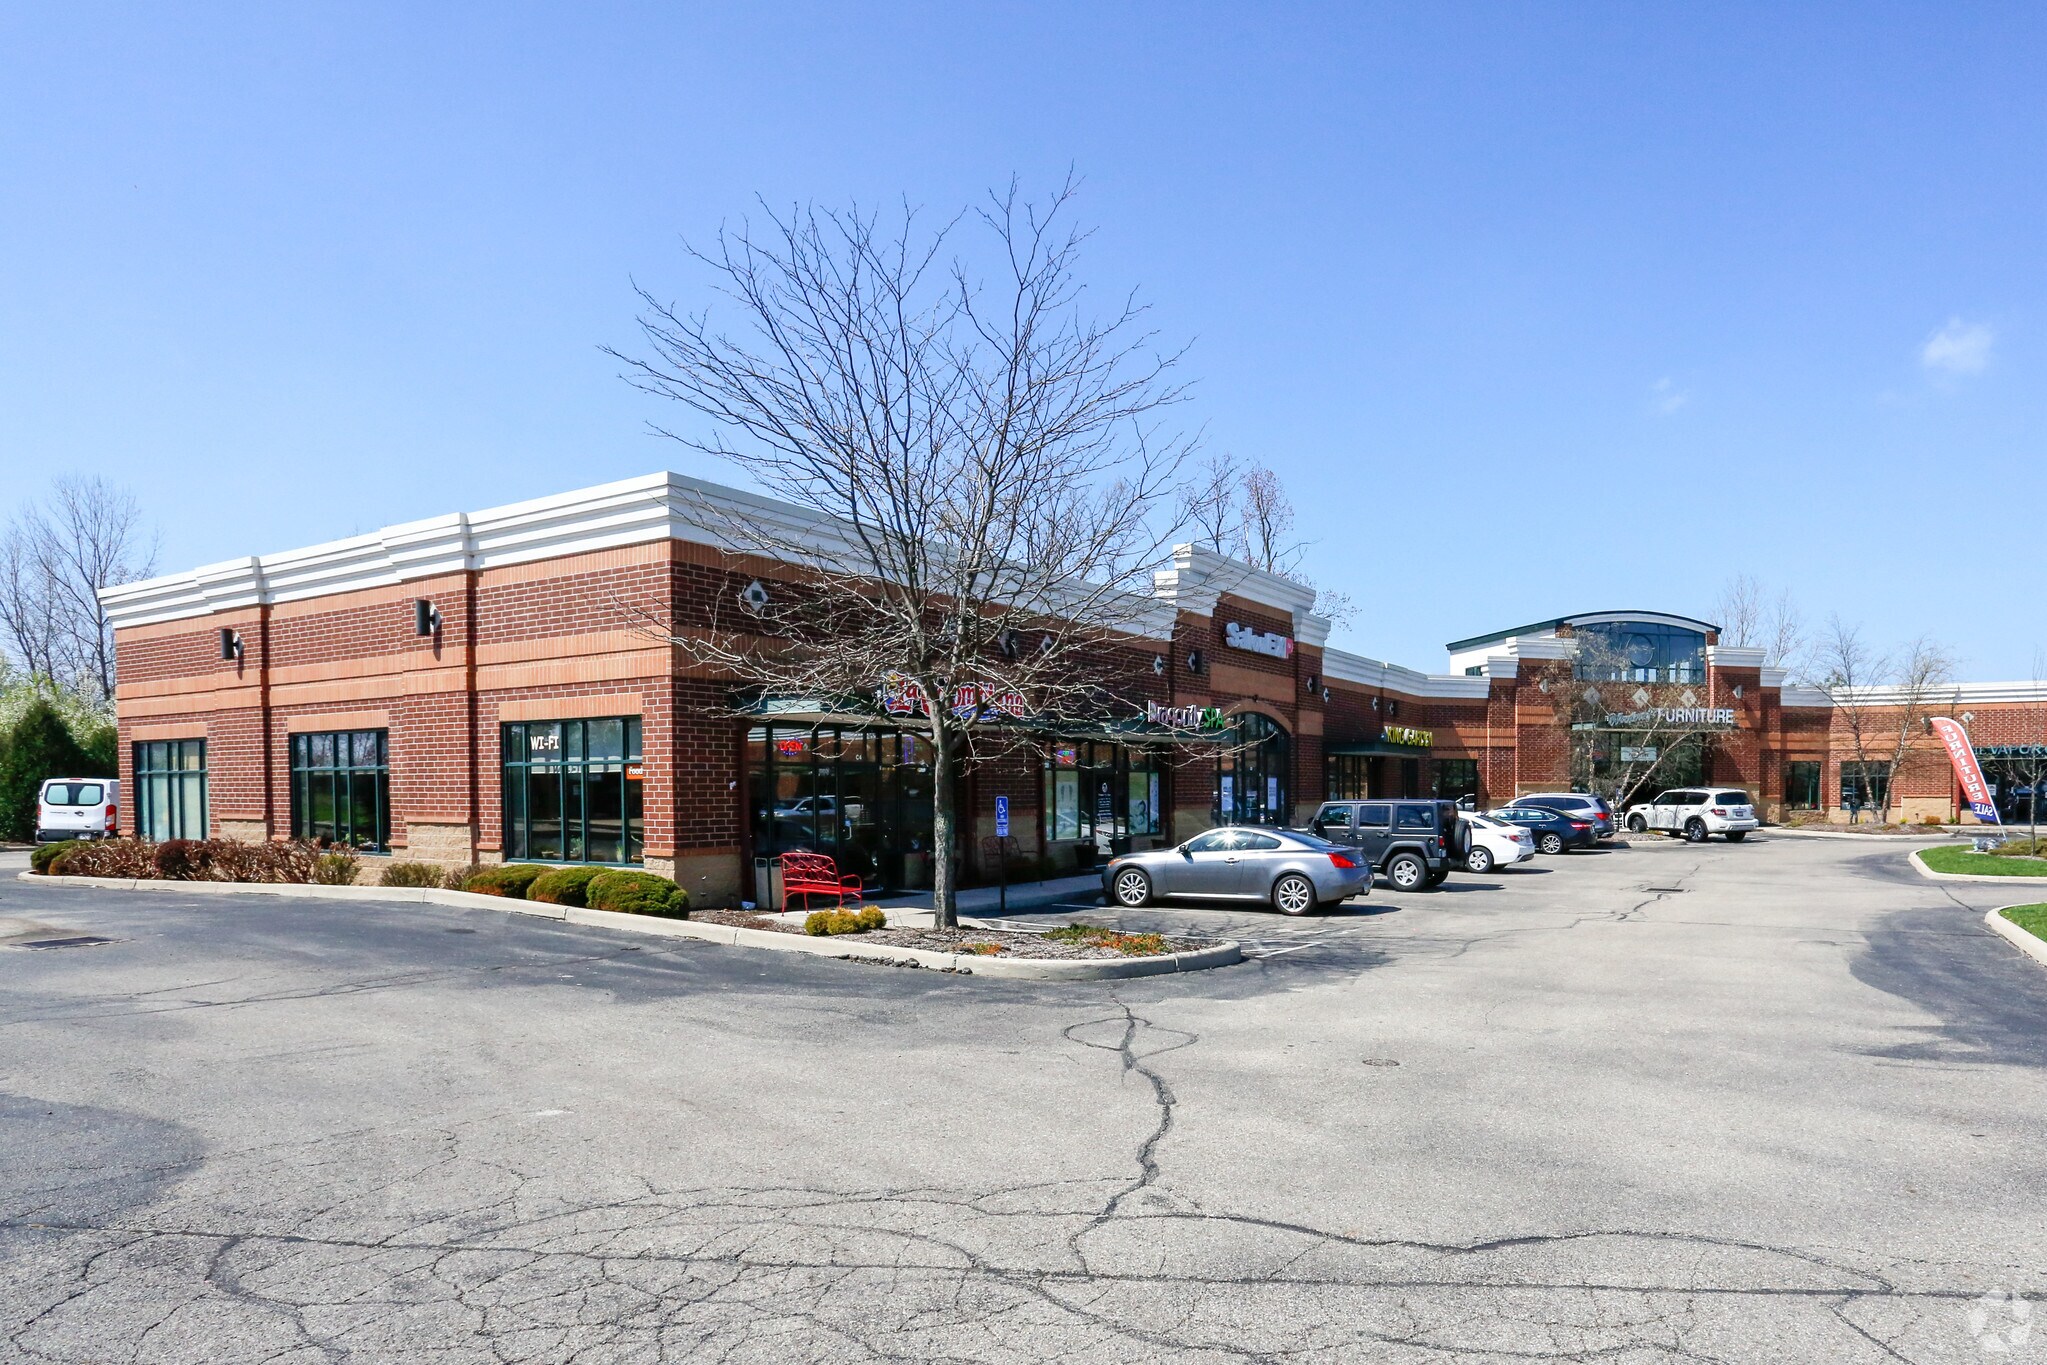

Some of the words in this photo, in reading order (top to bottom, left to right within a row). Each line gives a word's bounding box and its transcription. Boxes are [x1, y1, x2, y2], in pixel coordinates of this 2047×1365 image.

[1200, 708, 1225, 728] SPA
[1655, 708, 1735, 724] FURNITURE
[530, 736, 559, 750] WI-FI
[1384, 726, 1404, 745] KING
[1404, 729, 1433, 747] GARDEN
[1989, 743, 2041, 756] VAPOR
